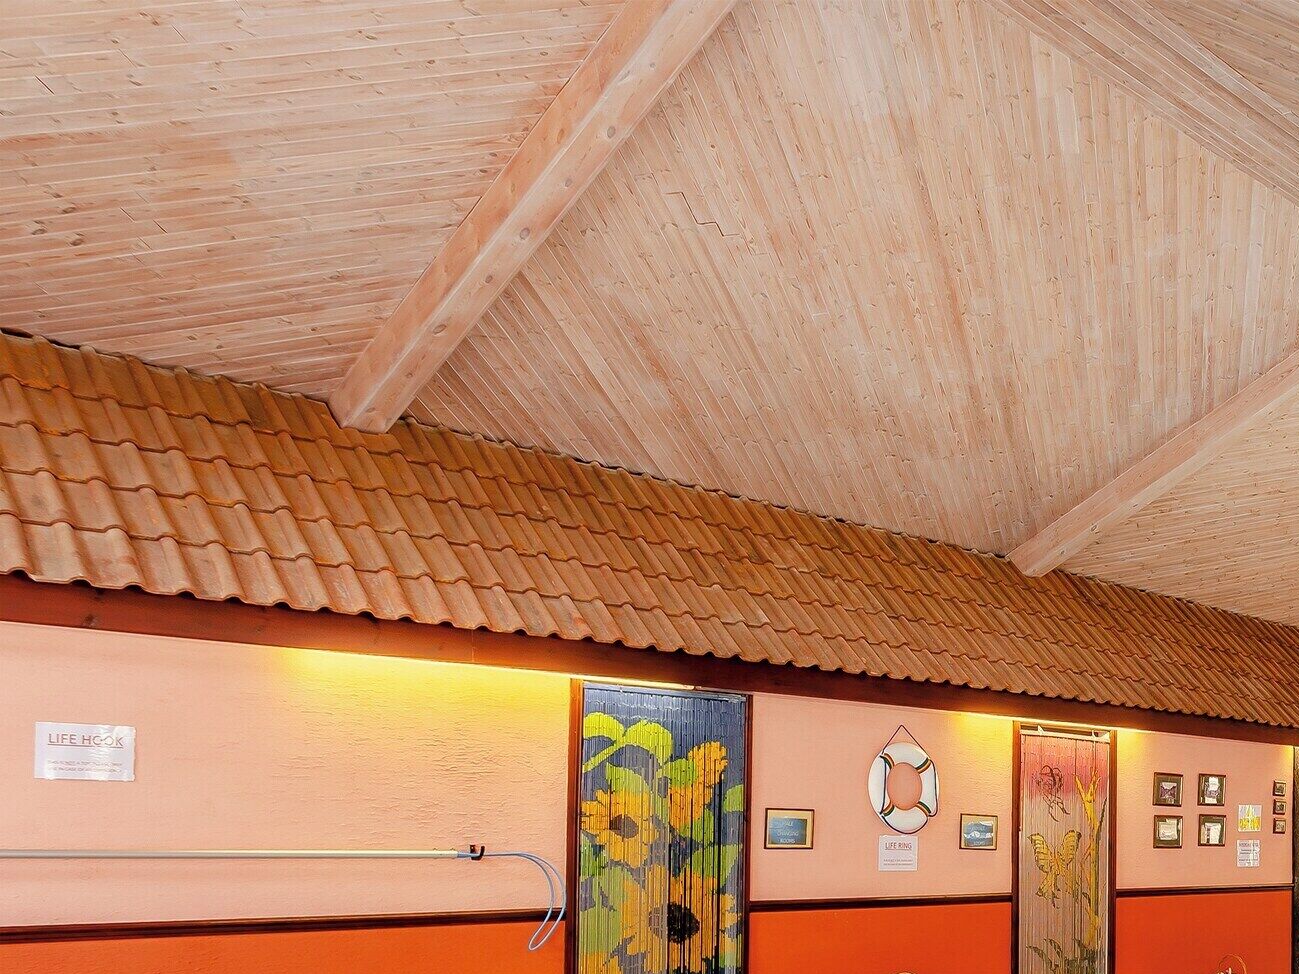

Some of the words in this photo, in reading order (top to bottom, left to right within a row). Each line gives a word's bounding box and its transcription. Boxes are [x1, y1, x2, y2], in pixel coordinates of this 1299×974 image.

[48, 733, 77, 745] LIFE
[81, 735, 124, 747] HOOK
[898, 842, 912, 850] RING
